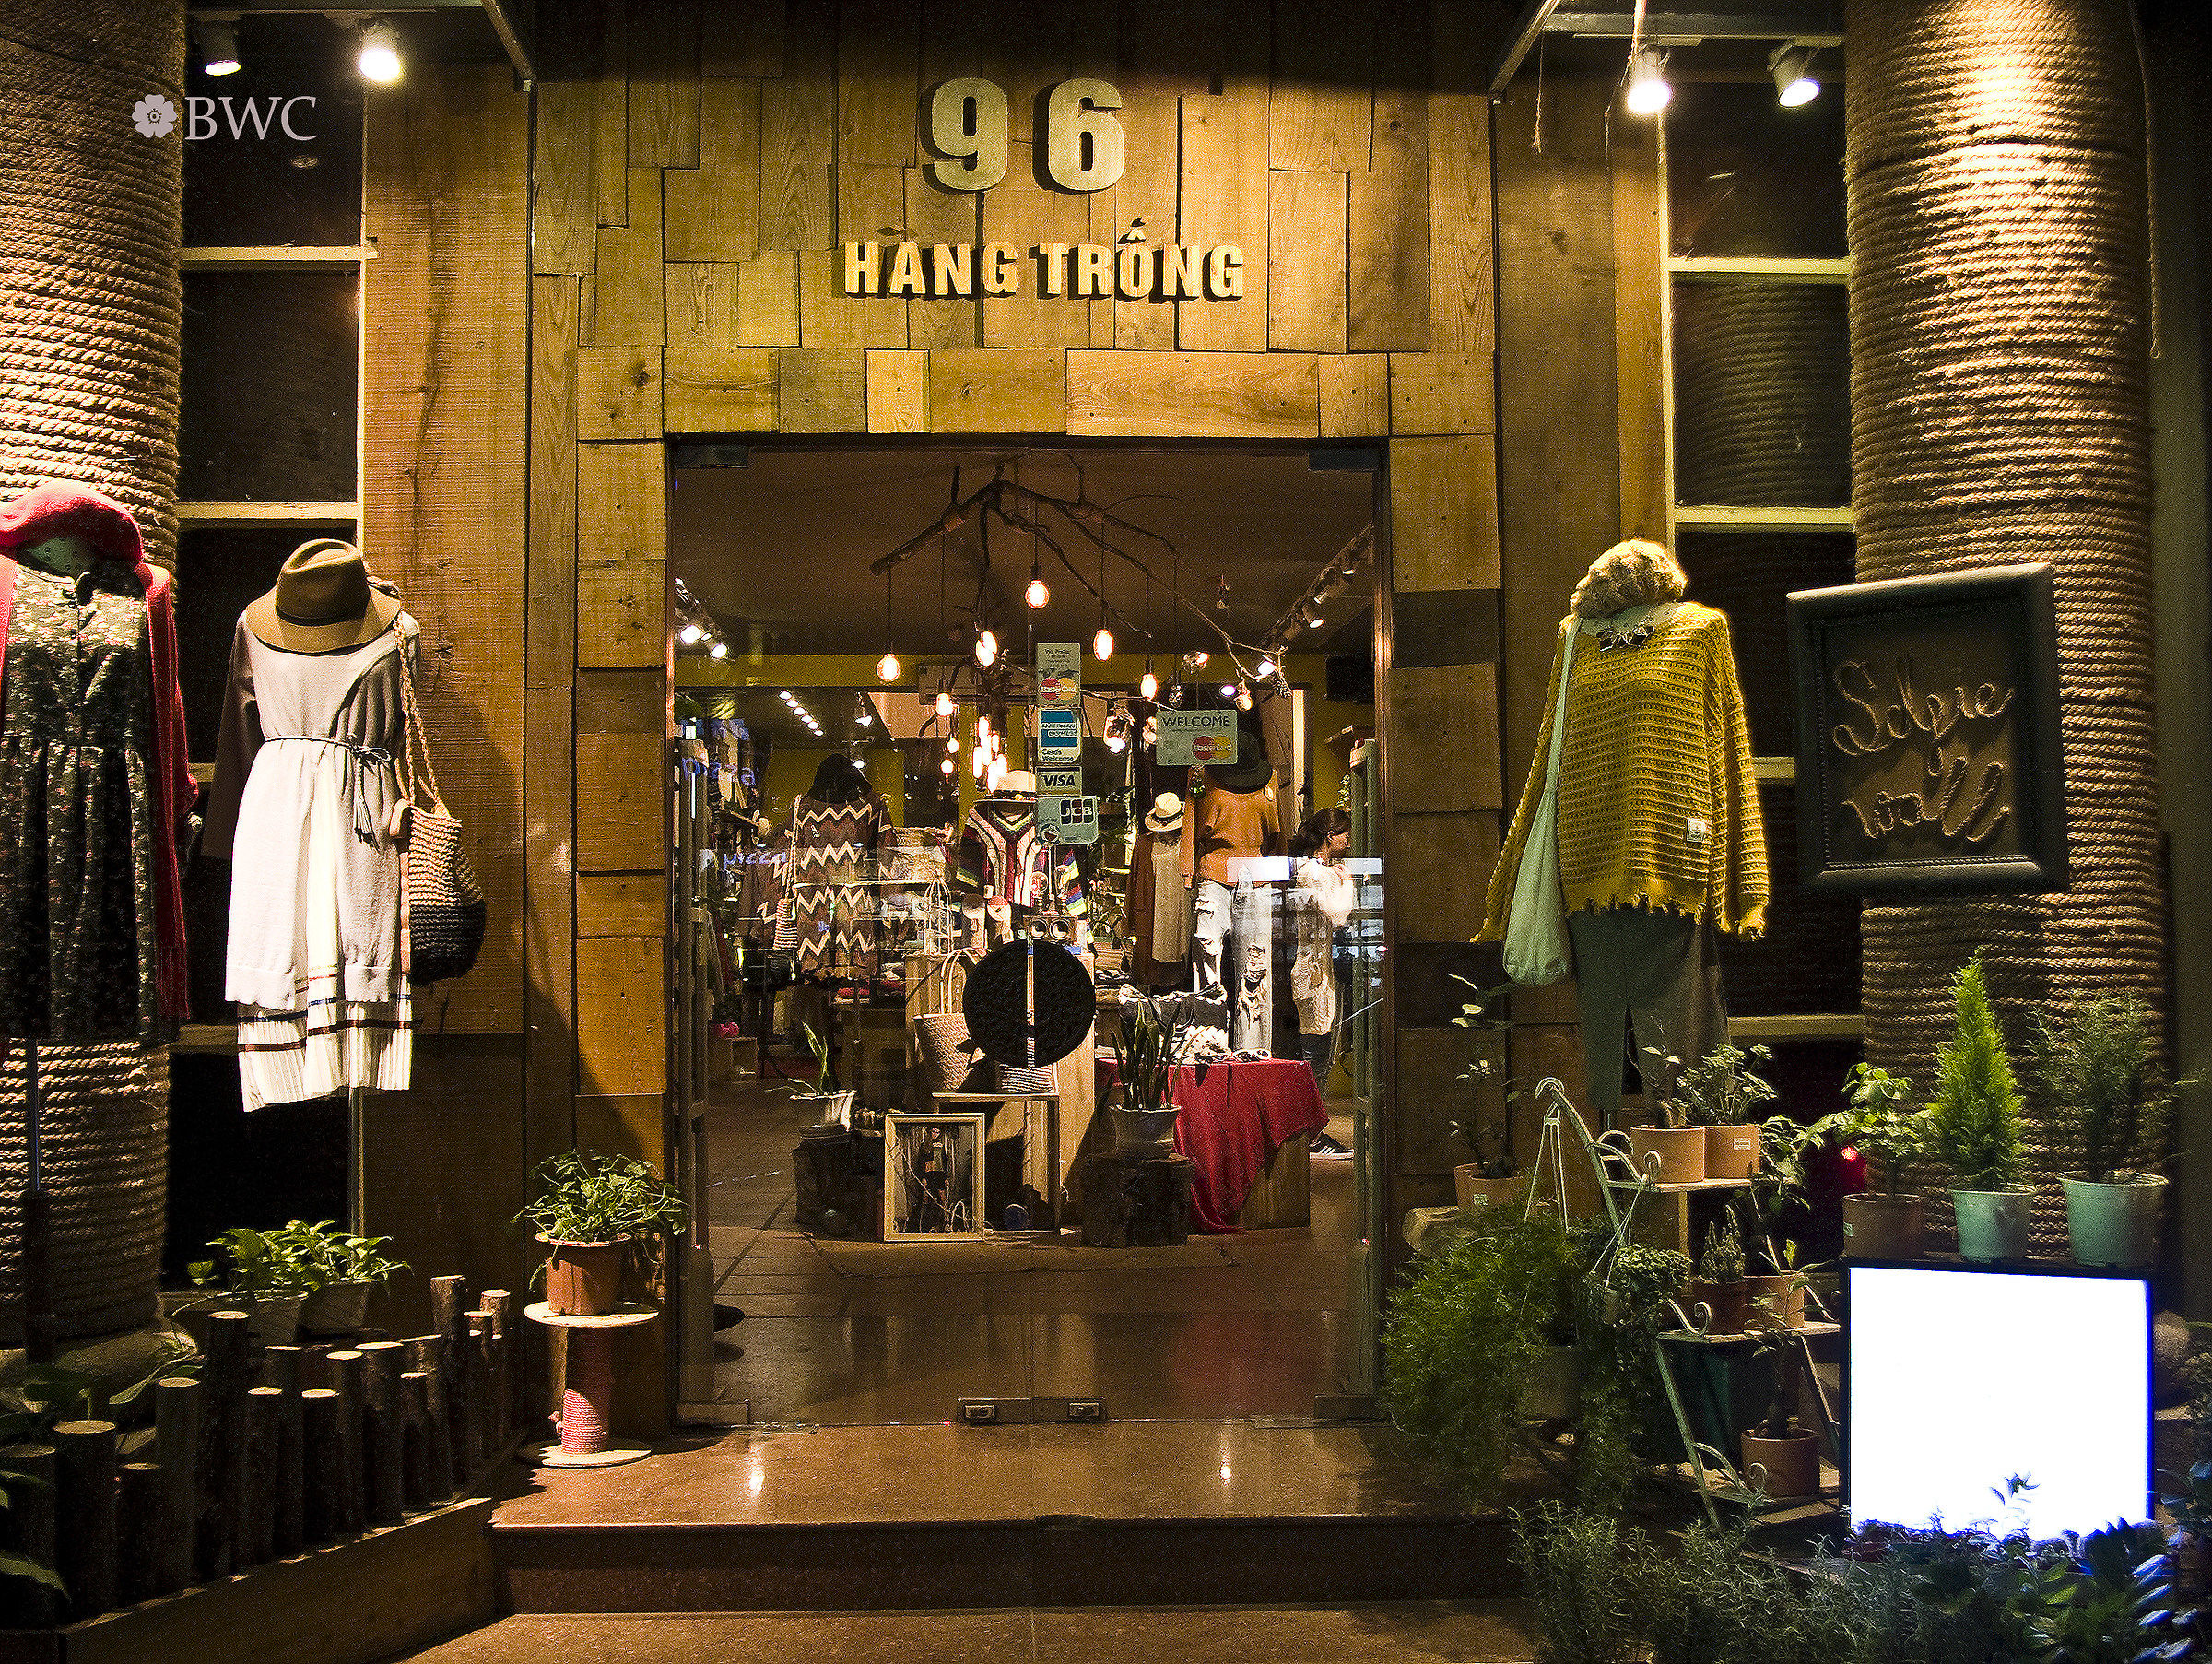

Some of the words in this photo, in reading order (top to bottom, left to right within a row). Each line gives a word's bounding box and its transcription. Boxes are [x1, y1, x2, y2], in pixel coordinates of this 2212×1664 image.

[931, 77, 1125, 192] 96
[843, 229, 1018, 297] HÀNG
[1038, 218, 1244, 299] TRỐNG
[1161, 715, 1230, 727] WELCOME
[1041, 774, 1076, 787] VISA
[1060, 807, 1093, 817] JCB
